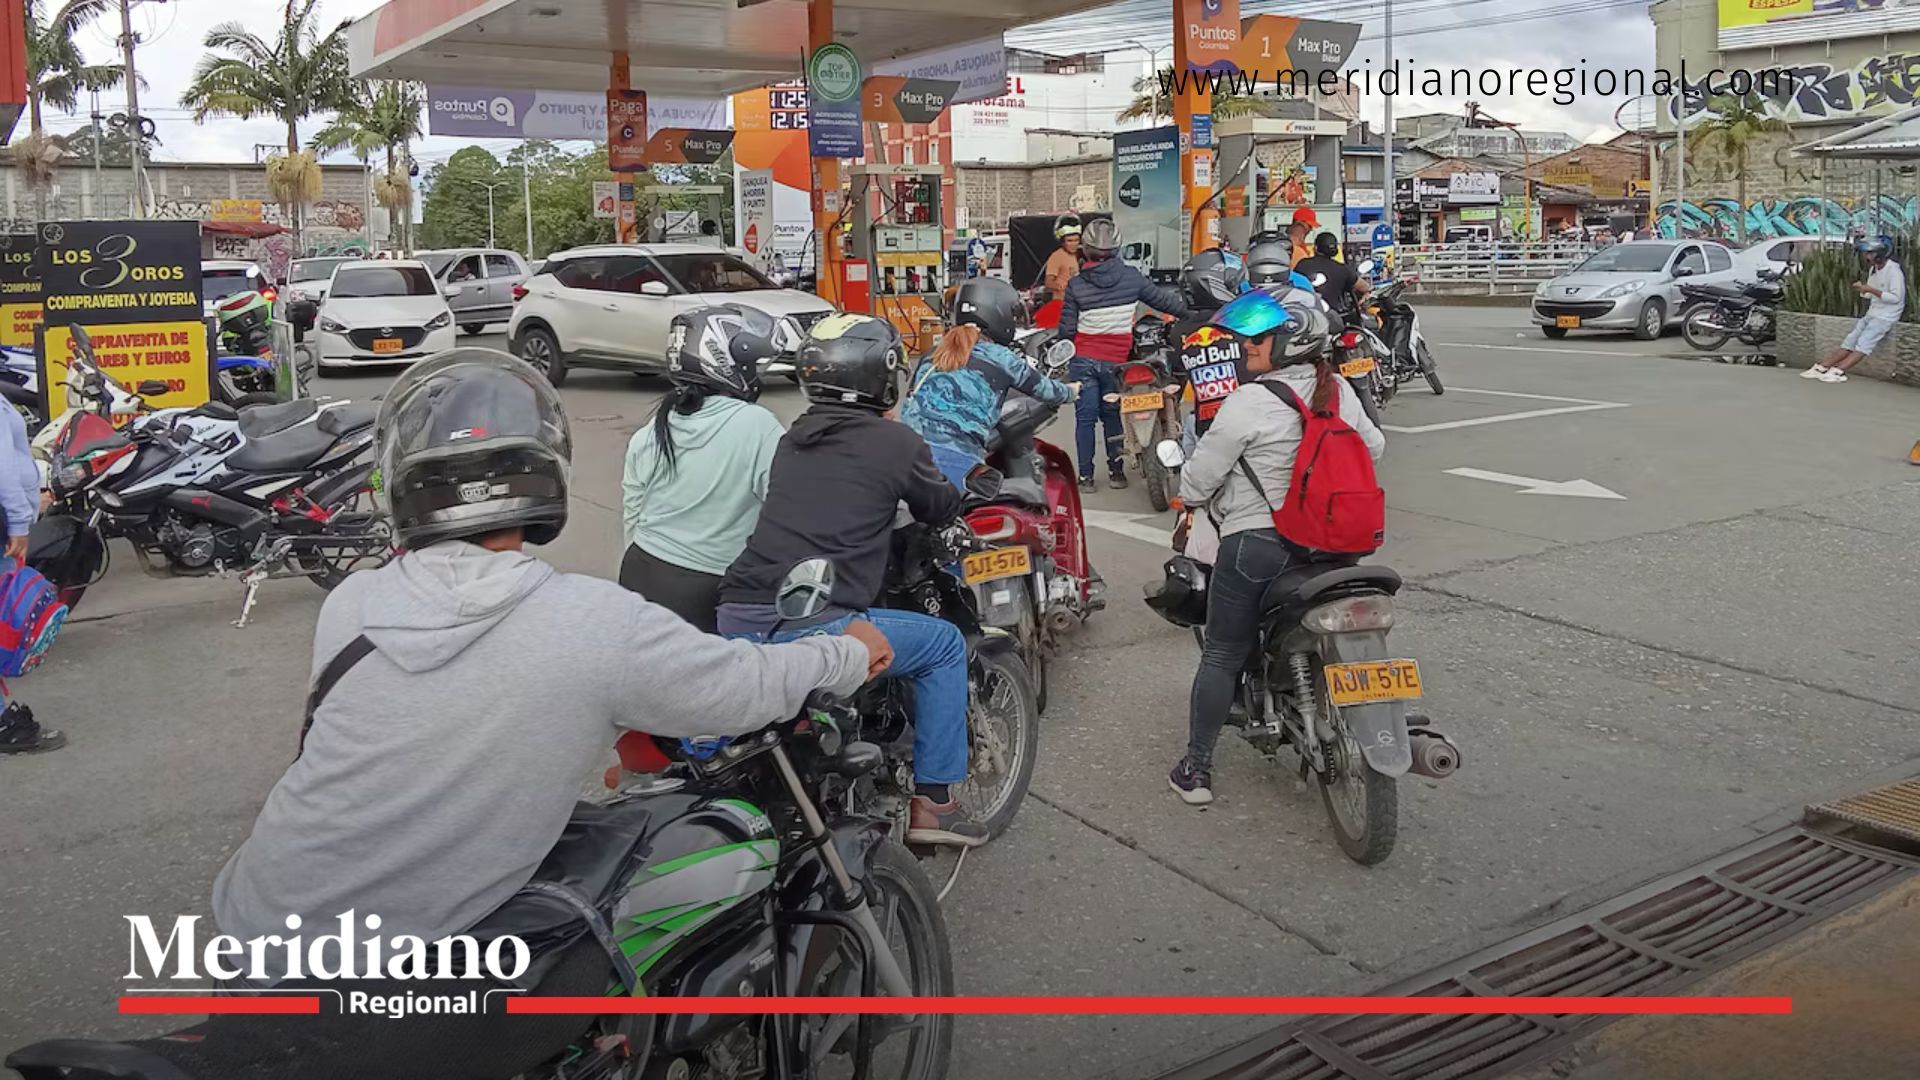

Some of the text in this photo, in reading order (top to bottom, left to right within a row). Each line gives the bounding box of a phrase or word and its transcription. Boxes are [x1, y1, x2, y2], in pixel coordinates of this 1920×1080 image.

[1190, 24, 1237, 40] Puntos
[1198, 41, 1230, 50] Colombia
[1260, 35, 1271, 58] 1
[1298, 38, 1341, 54] Max Pro
[827, 63, 844, 71] TOP
[873, 93, 883, 108] 3
[900, 91, 944, 105] Max Pro
[609, 100, 643, 116] Paga
[611, 144, 645, 154] Puntos
[685, 139, 722, 151] Max Pro
[1145, 161, 1159, 169] CON
[741, 177, 768, 188] TANQUEA
[743, 188, 766, 198] AHORRA
[747, 199, 766, 208] PUNTO
[774, 224, 805, 233] Puntos
[4, 253, 32, 263] LOS
[53, 250, 92, 264] LOS
[80, 234, 137, 289] 3
[131, 266, 185, 281] OROS
[1, 283, 42, 293] COMPRAV
[47, 291, 197, 311] COMPRAVENTA Y JOYERIA
[888, 305, 928, 317] Max Pro
[66, 332, 189, 351] CMPRAVENTA DE
[132, 354, 143, 366] Y
[145, 351, 191, 364] EUROS
[1181, 342, 1241, 370] Red Bull
[1192, 364, 1233, 385] LIQUI
[1196, 379, 1236, 400] MOLY
